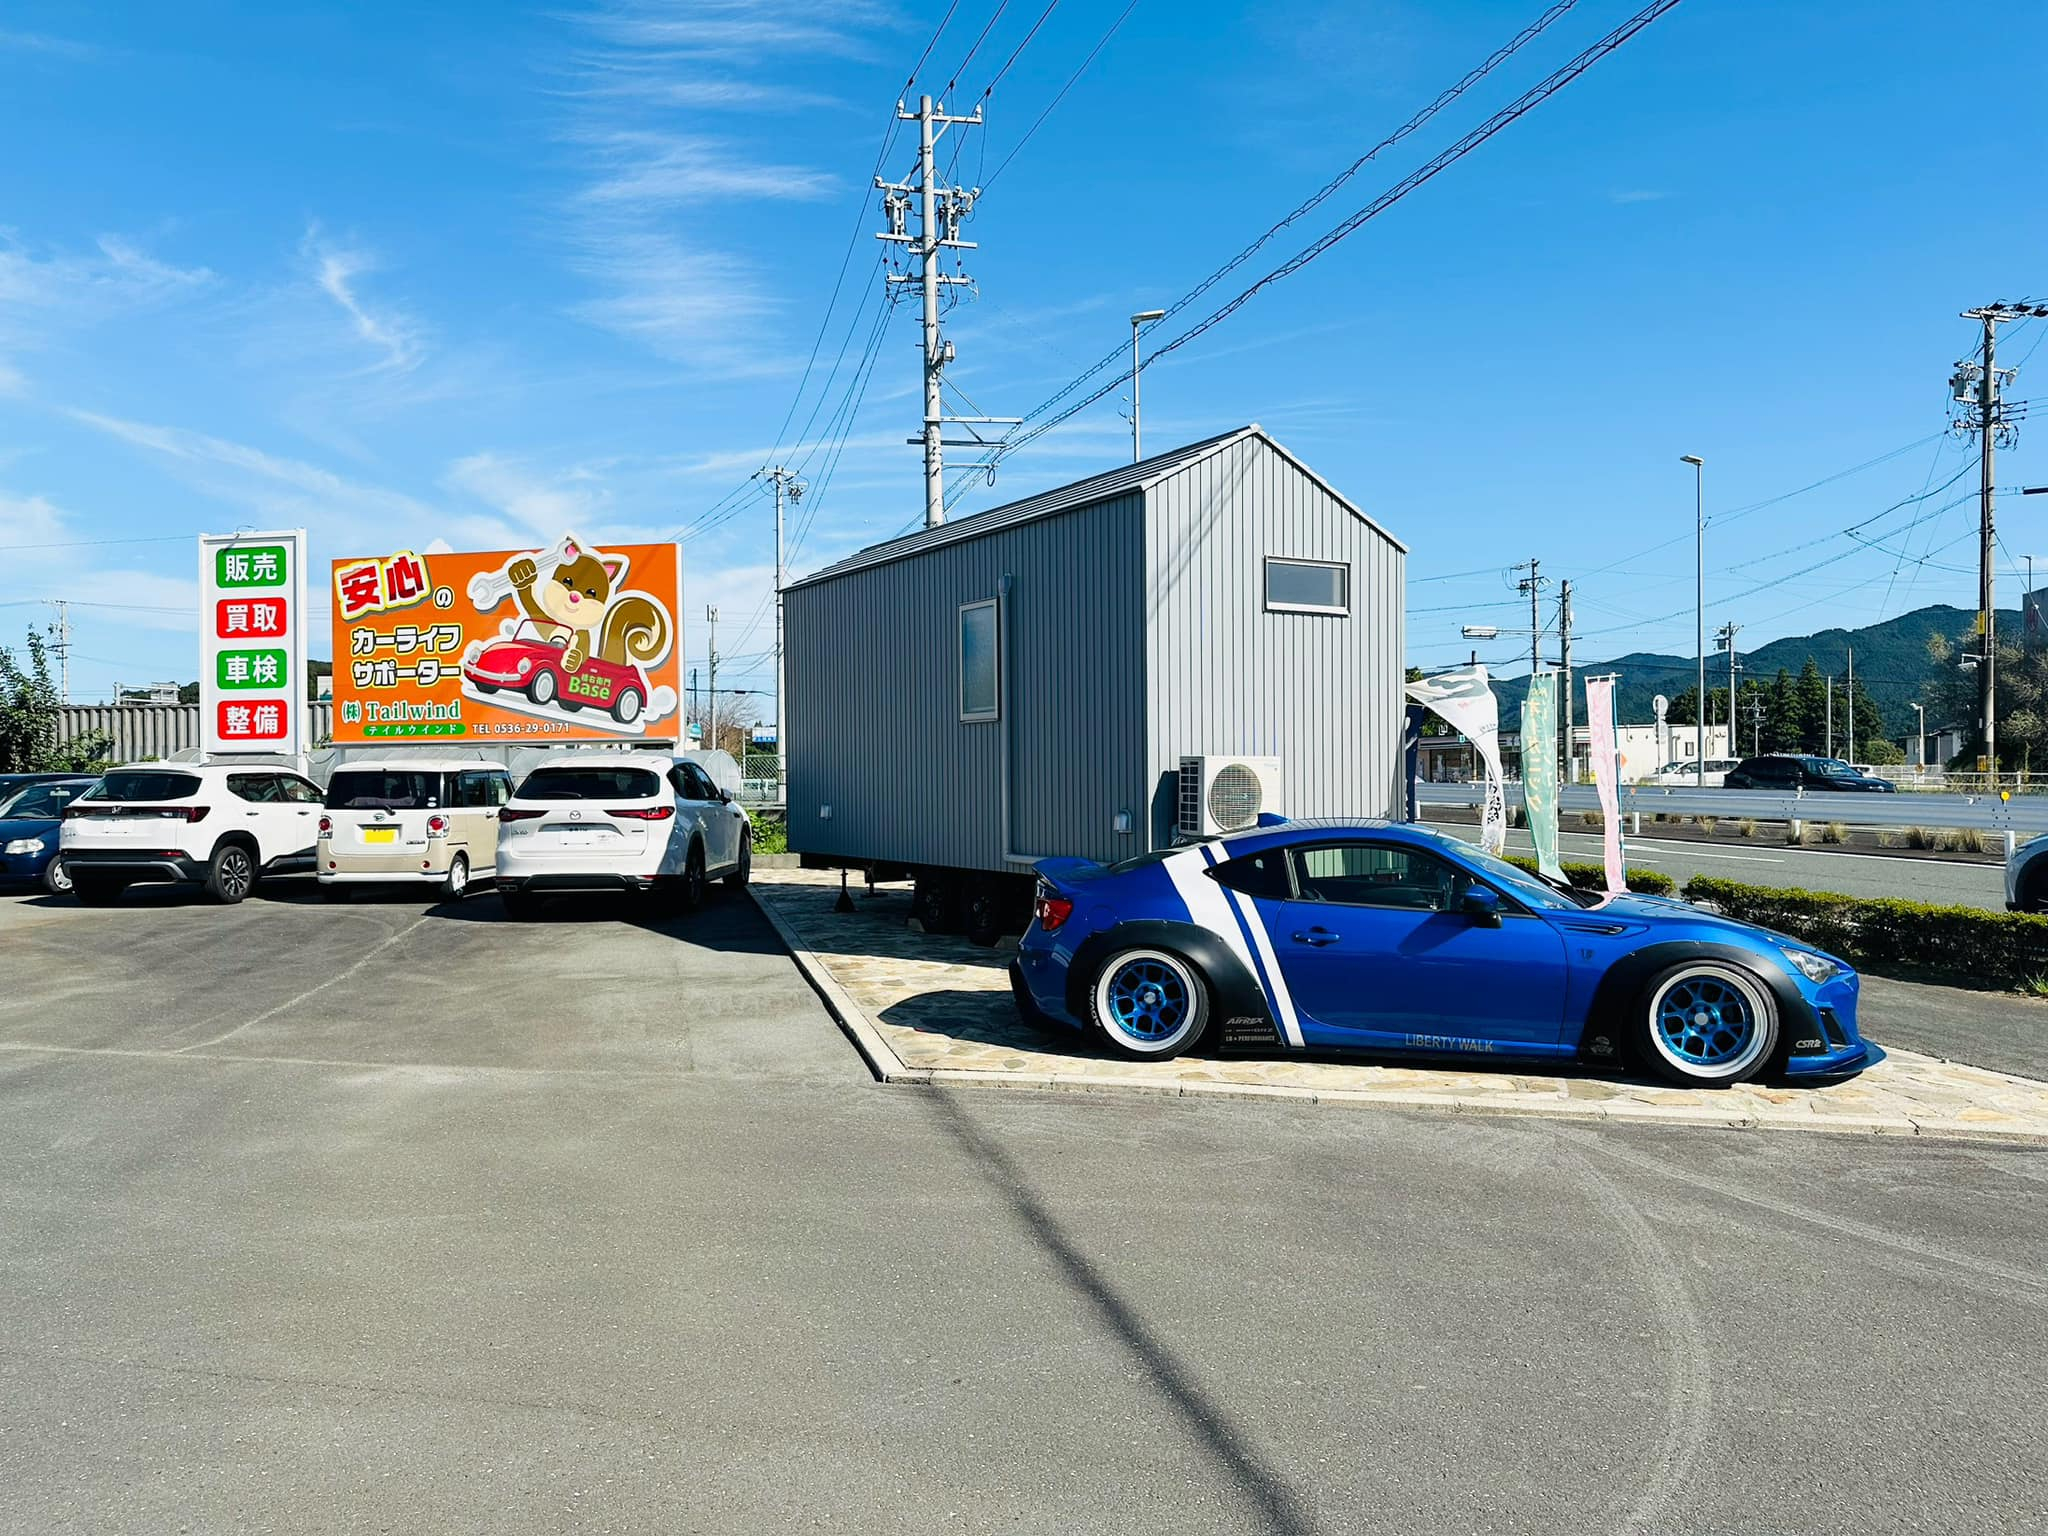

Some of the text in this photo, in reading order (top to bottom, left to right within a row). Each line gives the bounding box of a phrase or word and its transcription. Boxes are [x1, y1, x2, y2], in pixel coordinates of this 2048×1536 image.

[225, 552, 278, 582] 販売
[225, 603, 278, 633] 買取
[352, 626, 461, 654] カーライフ
[225, 654, 278, 685] 車検
[353, 659, 461, 687] サポーター
[568, 676, 611, 700] Base
[225, 705, 279, 735] 整備
[365, 699, 461, 721] Tailwind
[369, 725, 457, 736] テイルウインド
[472, 722, 570, 734] TEL 0536-29-0171
[1405, 1033, 1494, 1053] LIBERTY WALK
